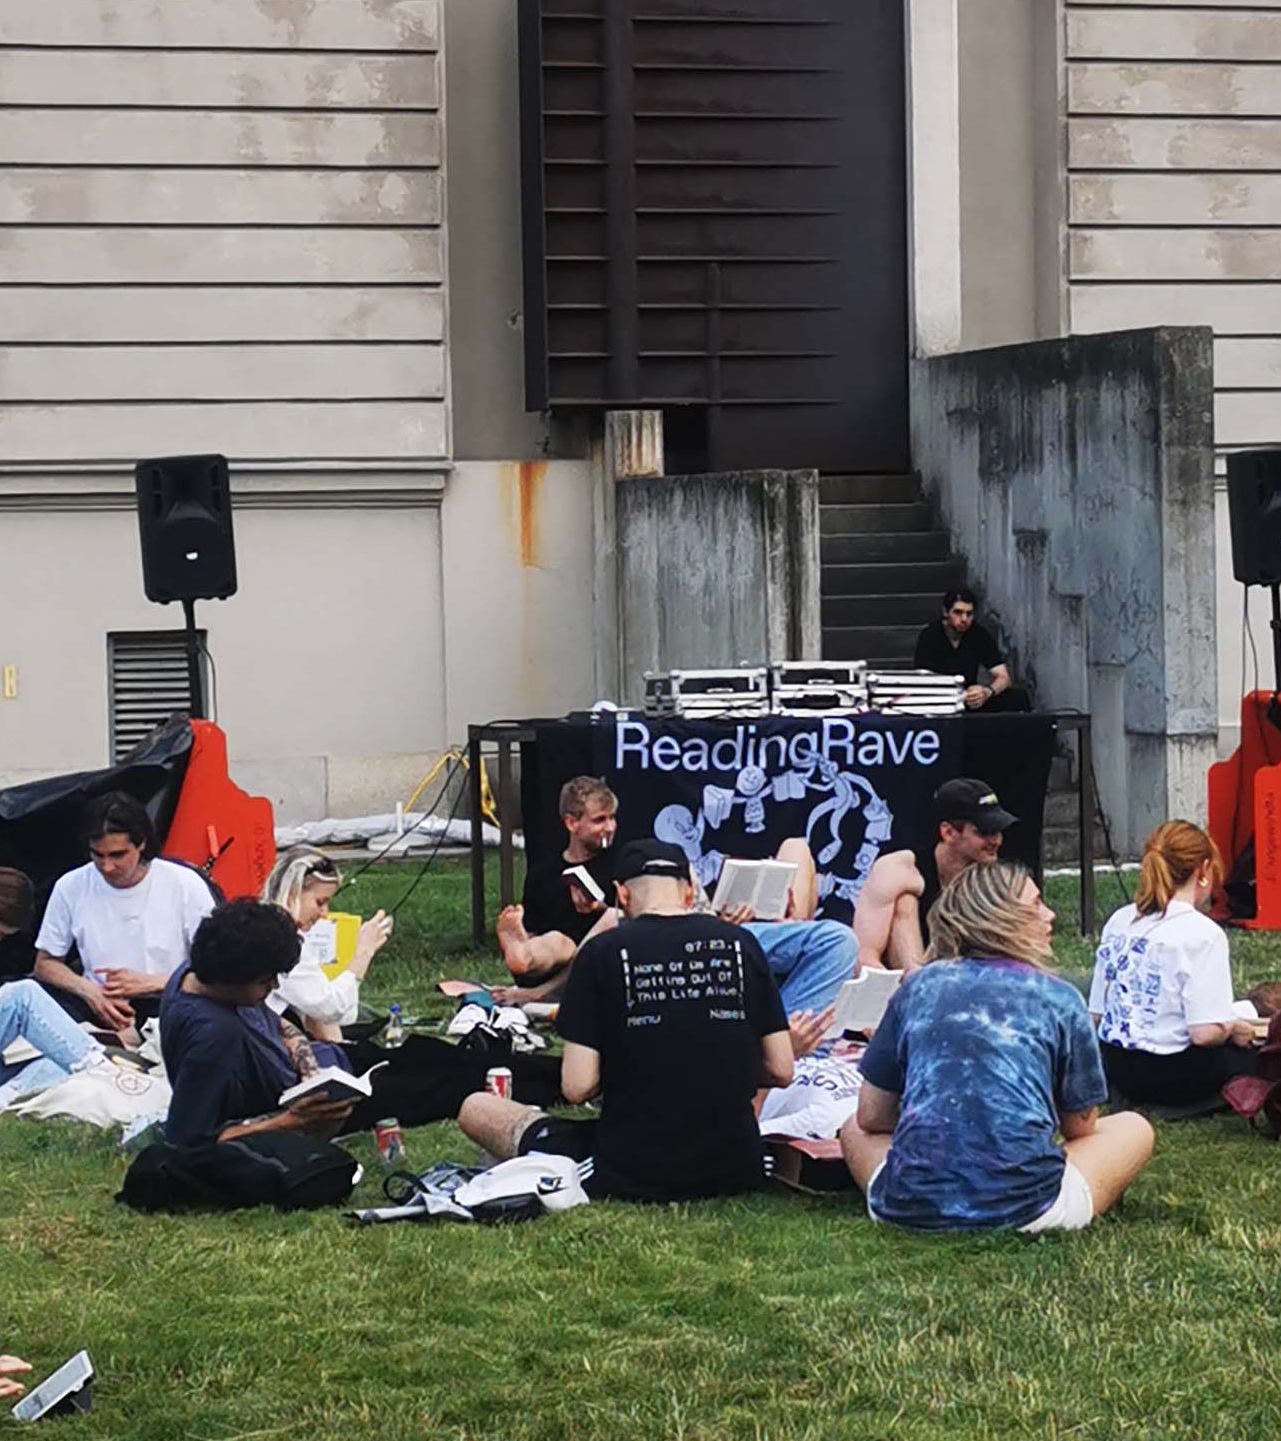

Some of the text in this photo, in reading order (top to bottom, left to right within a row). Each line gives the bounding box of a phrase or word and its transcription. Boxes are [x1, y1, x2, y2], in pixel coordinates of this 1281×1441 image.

[634, 963, 664, 975] None
[637, 991, 666, 1003] This
[671, 987, 700, 999] Life
[627, 1015, 661, 1028] Menu
